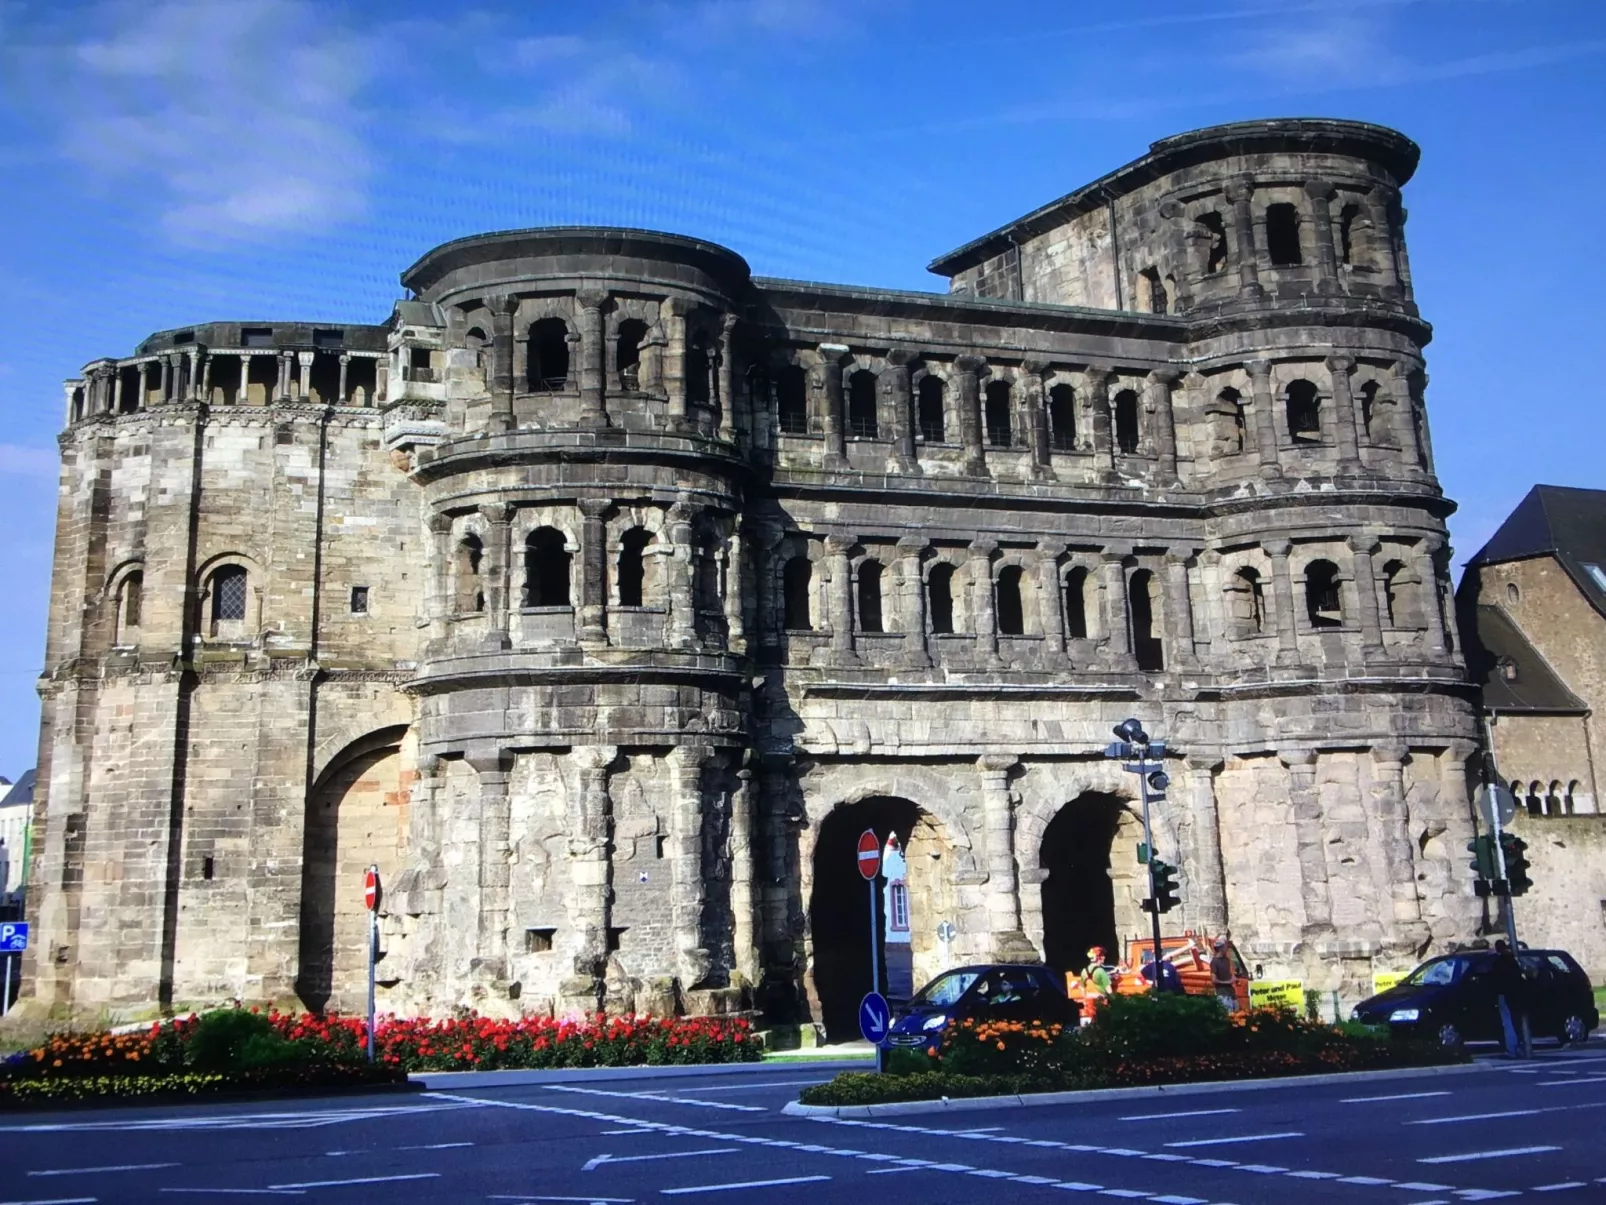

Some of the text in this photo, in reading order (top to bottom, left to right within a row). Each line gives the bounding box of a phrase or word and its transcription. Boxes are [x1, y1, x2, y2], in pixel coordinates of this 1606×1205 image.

[2, 925, 16, 942] P
[1250, 988, 1270, 996] Peter
[1286, 982, 1302, 990] Paul
